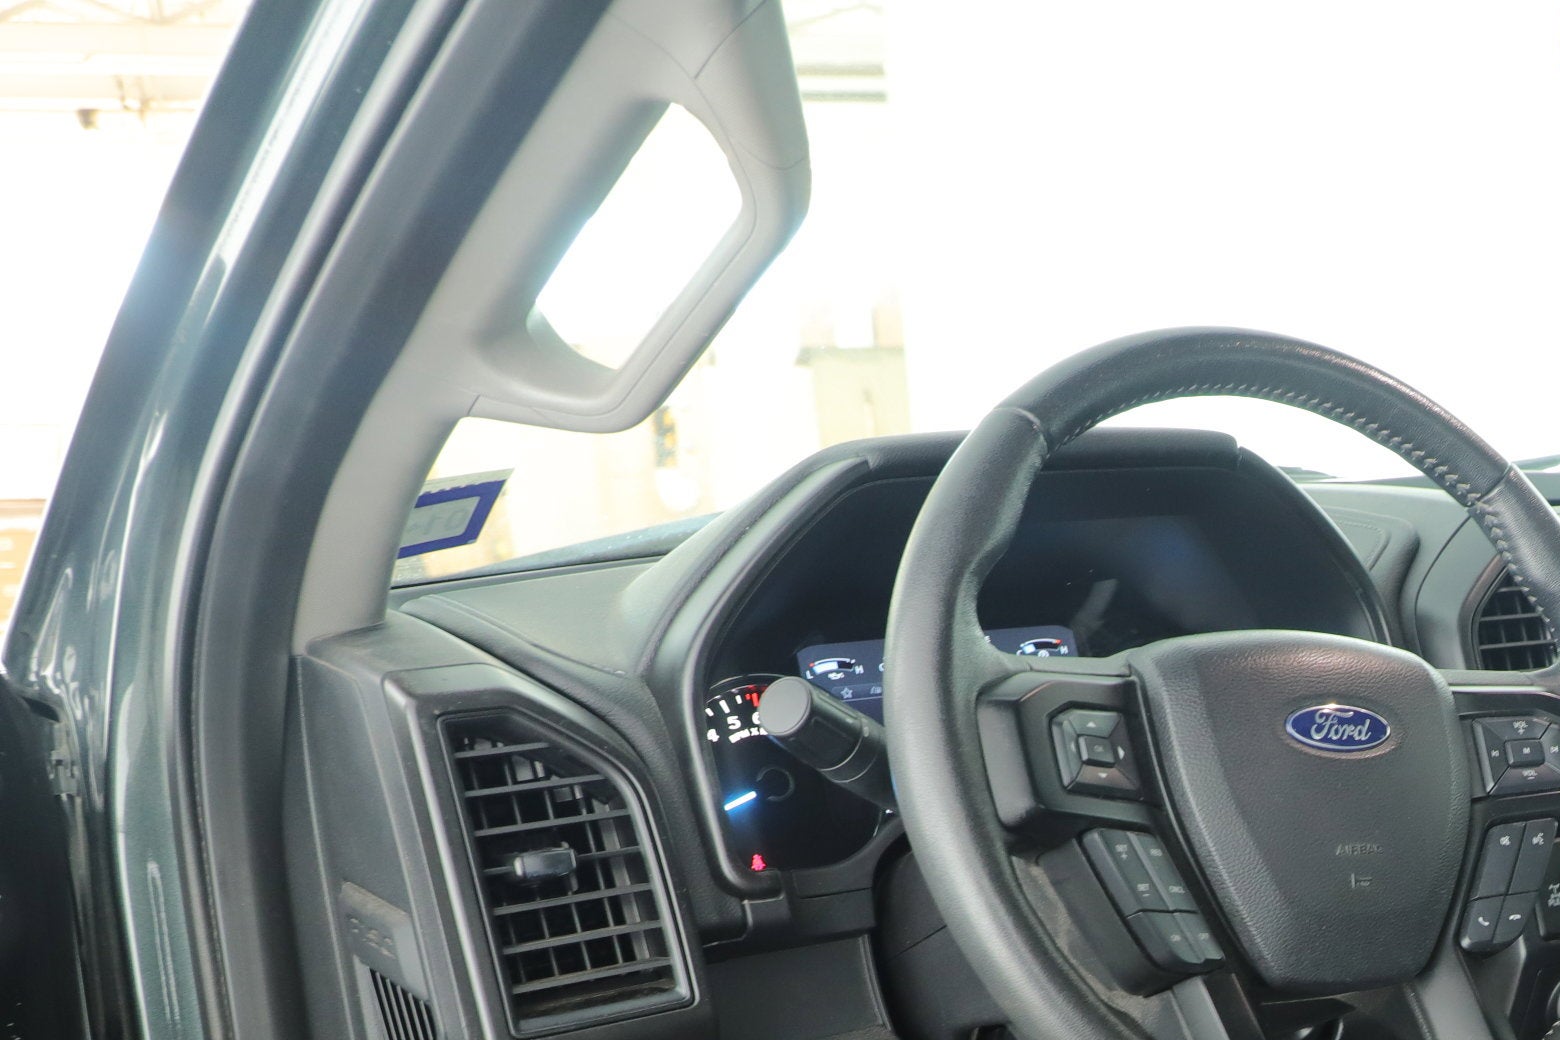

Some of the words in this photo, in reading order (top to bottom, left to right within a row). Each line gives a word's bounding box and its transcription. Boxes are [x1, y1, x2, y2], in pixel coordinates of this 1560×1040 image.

[726, 715, 742, 730] 5
[1310, 708, 1372, 741] Ford
[706, 728, 720, 743] 4
